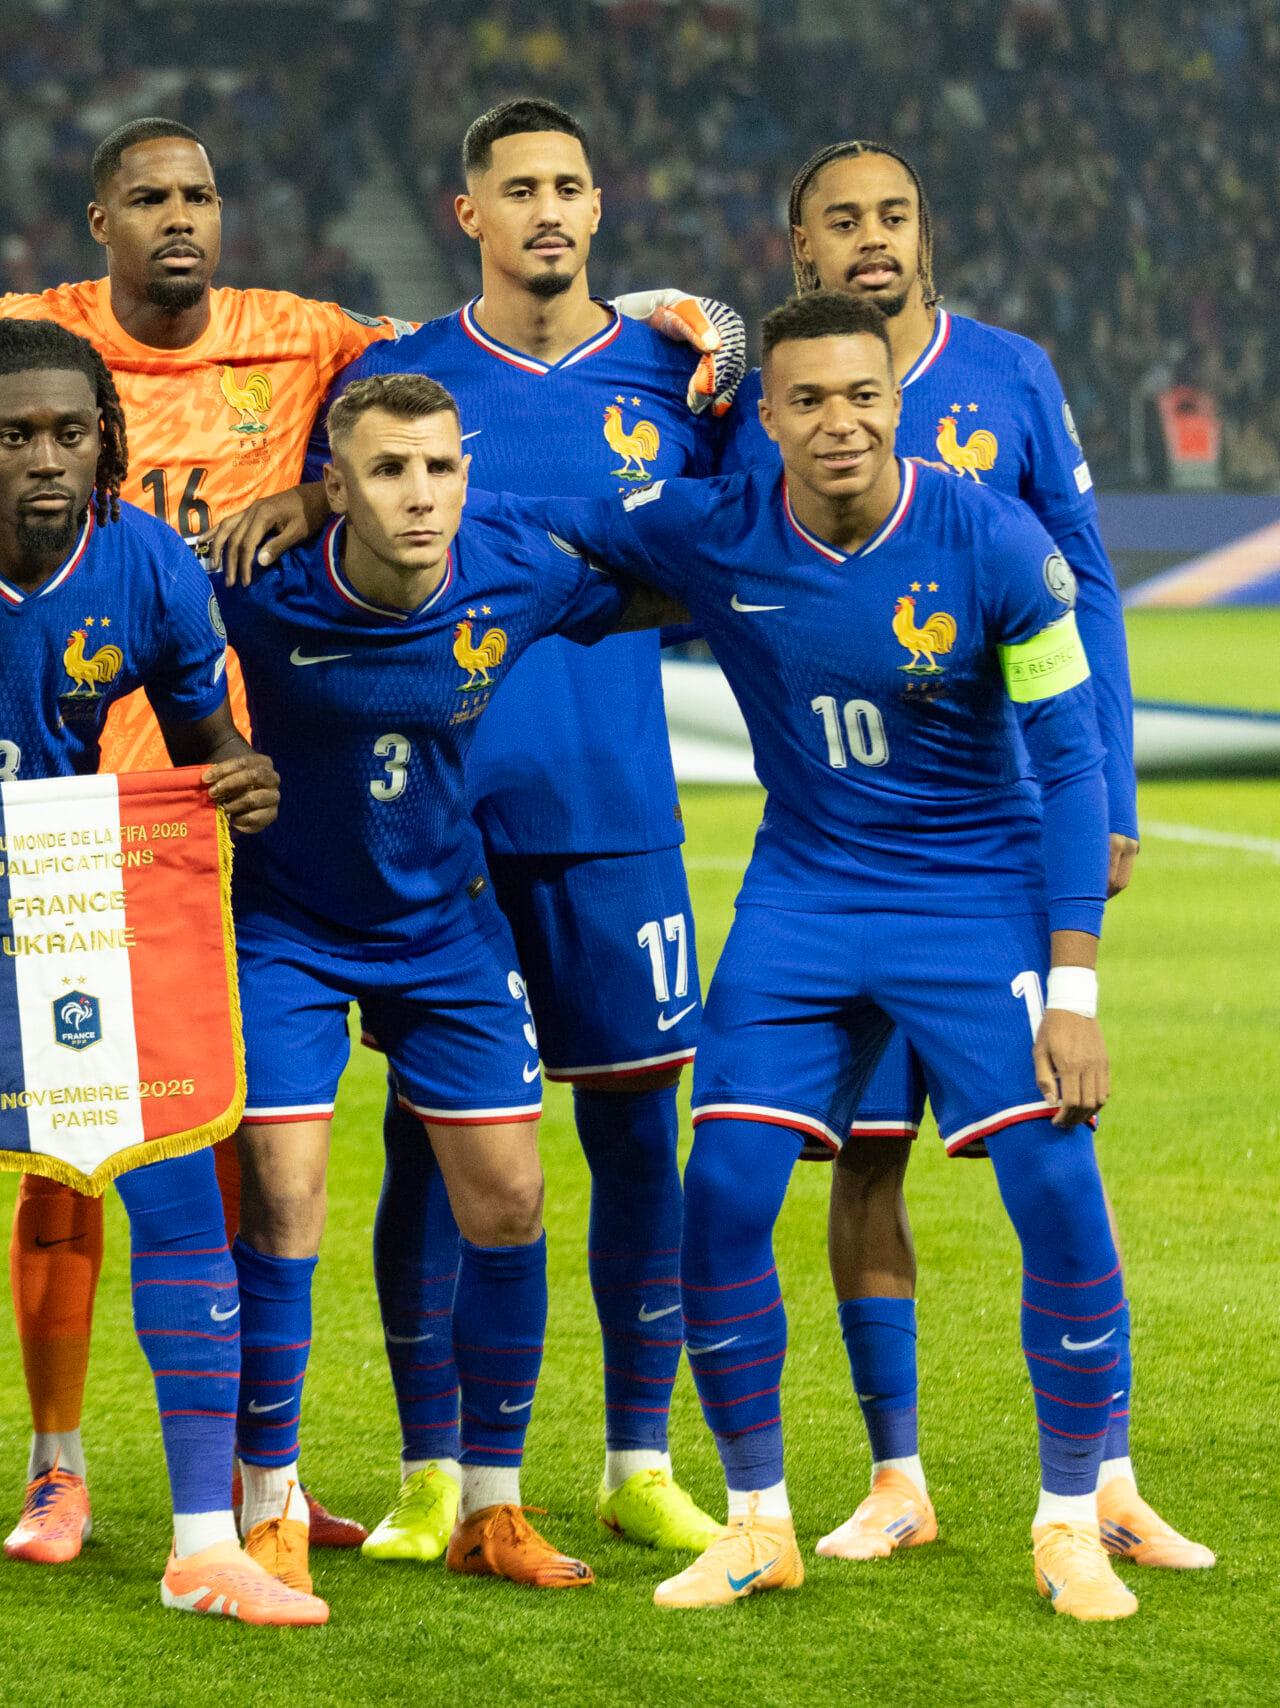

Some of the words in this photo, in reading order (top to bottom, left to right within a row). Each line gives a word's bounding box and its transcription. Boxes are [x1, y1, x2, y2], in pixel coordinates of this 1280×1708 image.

[141, 467, 214, 538] 16
[1028, 645, 1076, 675] RESPEC
[811, 695, 889, 769] 10
[370, 733, 411, 802] 3
[13, 832, 66, 851] MONDE
[71, 830, 91, 846] DE
[94, 828, 113, 845] LA
[120, 825, 147, 843] FIFA
[151, 823, 188, 839] 2026
[7, 890, 128, 919] FRANCE
[2, 927, 137, 957] UKRAINE
[636, 912, 688, 1003] 17
[62, 1031, 96, 1041] FRANCE
[0, 1085, 129, 1111] NOVEMBRE
[137, 1078, 195, 1098] 2025
[51, 1109, 118, 1130] PARIS
